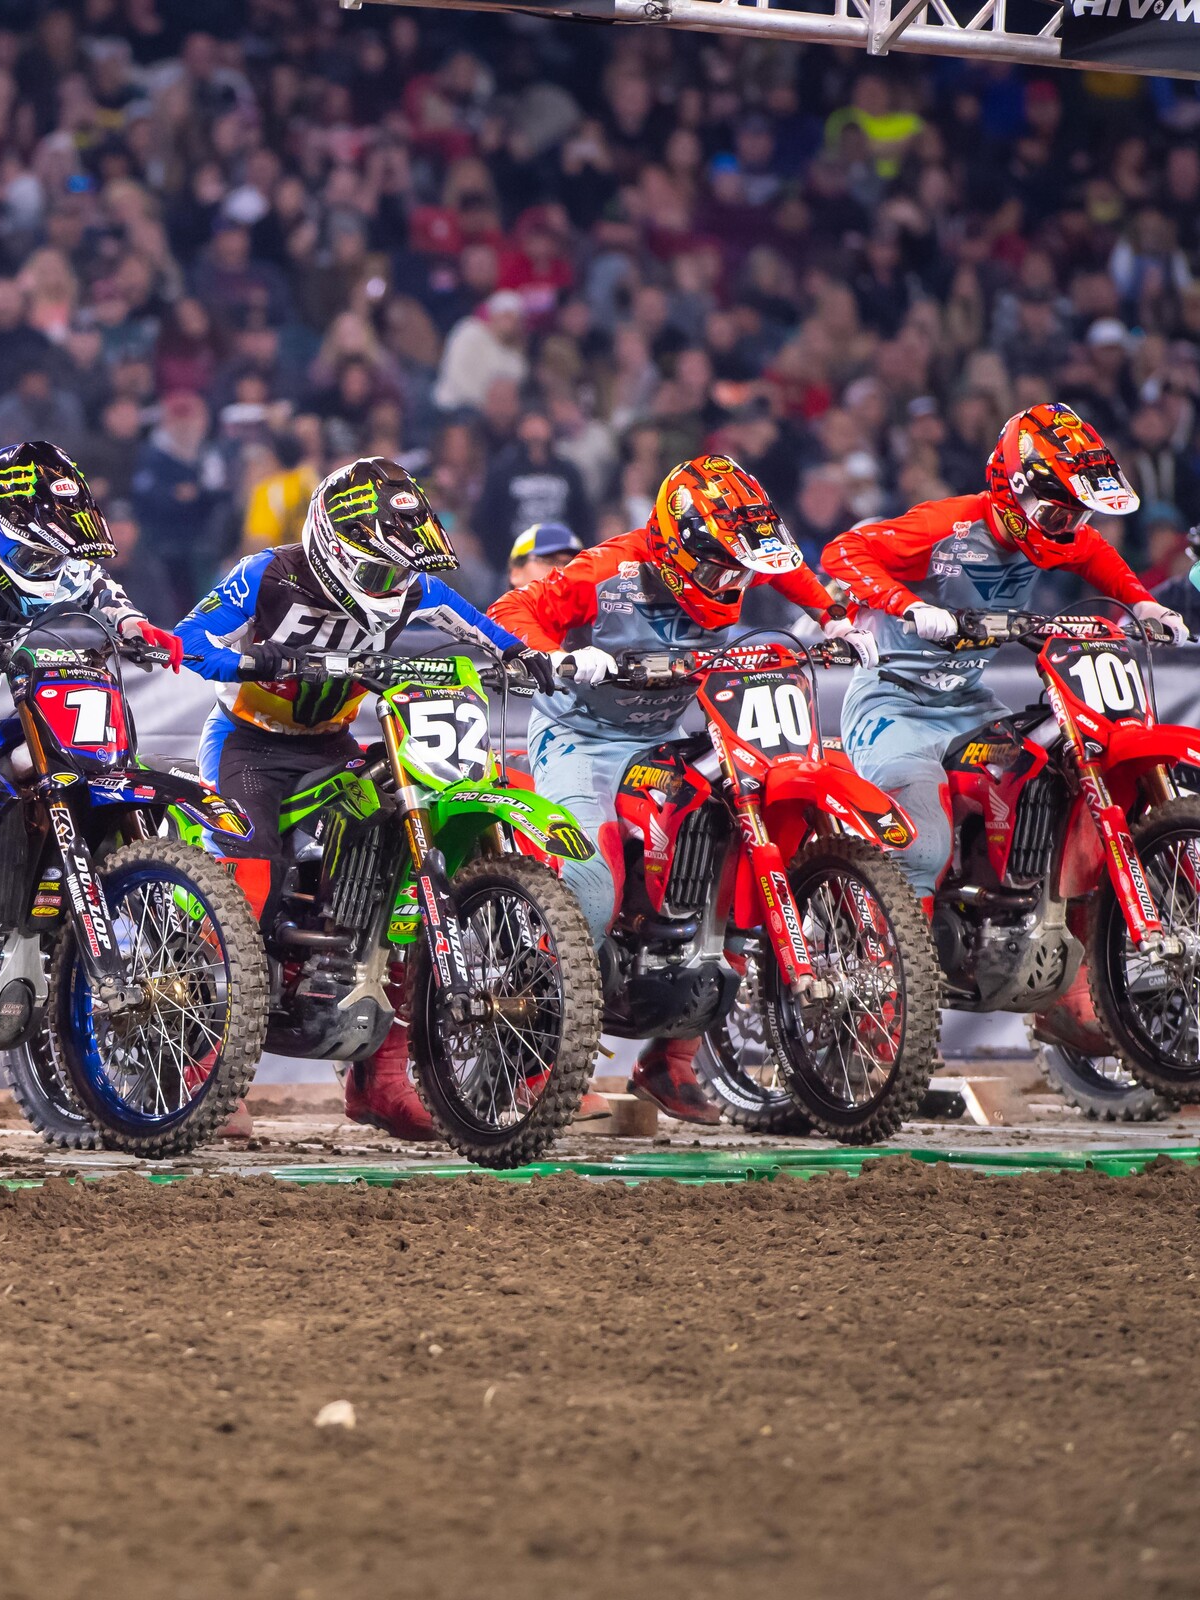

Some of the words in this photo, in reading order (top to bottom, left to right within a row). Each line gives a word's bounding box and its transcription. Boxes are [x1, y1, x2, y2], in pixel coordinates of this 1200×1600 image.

[395, 497, 415, 506] BELL
[1004, 508, 1027, 540] PENRITE
[310, 549, 343, 596] MONSTER
[661, 563, 683, 597] PENRITE
[269, 603, 386, 652] FOX
[1034, 622, 1103, 635] RENTHAL
[144, 651, 171, 660] ARC
[66, 668, 100, 679] MONSTER
[749, 672, 784, 681] MONSTER
[1069, 652, 1148, 714] 101
[431, 688, 466, 698] MONSTER
[1047, 686, 1065, 726] NGK
[64, 687, 111, 746] 1
[737, 684, 812, 749] 40
[105, 726, 117, 743] W
[409, 700, 489, 765] 52
[732, 748, 757, 769] SKDA
[777, 755, 803, 764] HONDA
[169, 766, 200, 783] Kawasa
[623, 764, 676, 793] PENRITE
[451, 792, 475, 802] PRO
[478, 792, 534, 813] CIRCUIT
[985, 821, 1011, 830] HONDA
[643, 851, 669, 861] HONDA
[66, 873, 86, 914] YAMALUBE
[420, 876, 440, 926] BRAKING
[760, 876, 775, 908] GALFER
[82, 914, 101, 958] BRAKING
